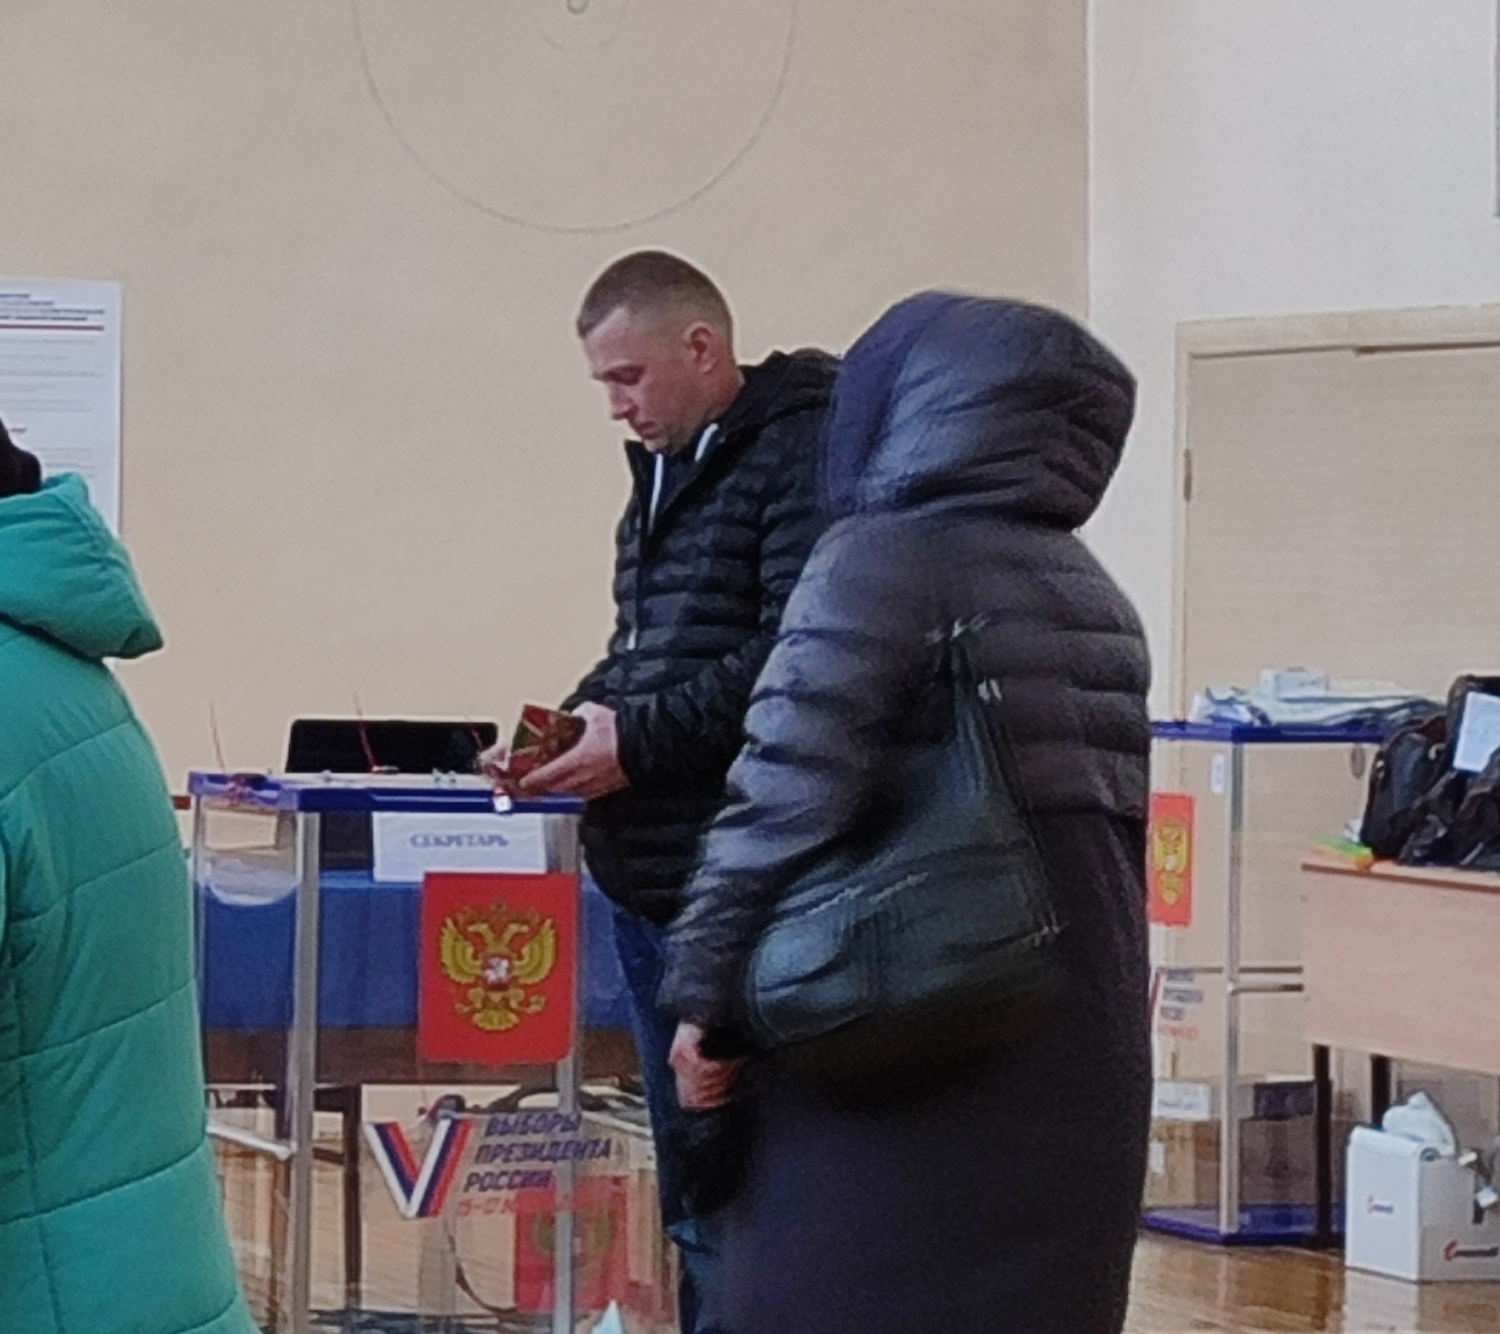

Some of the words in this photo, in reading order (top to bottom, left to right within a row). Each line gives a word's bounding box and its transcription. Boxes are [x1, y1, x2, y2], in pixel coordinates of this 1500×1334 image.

[408, 833, 509, 848] СЕКРЕТАРЬ
[483, 1111, 583, 1137] ВЫБОРЫ
[474, 1138, 612, 1164] ПРЕЗИДЕНТА
[462, 1169, 554, 1192] РОССИИ
